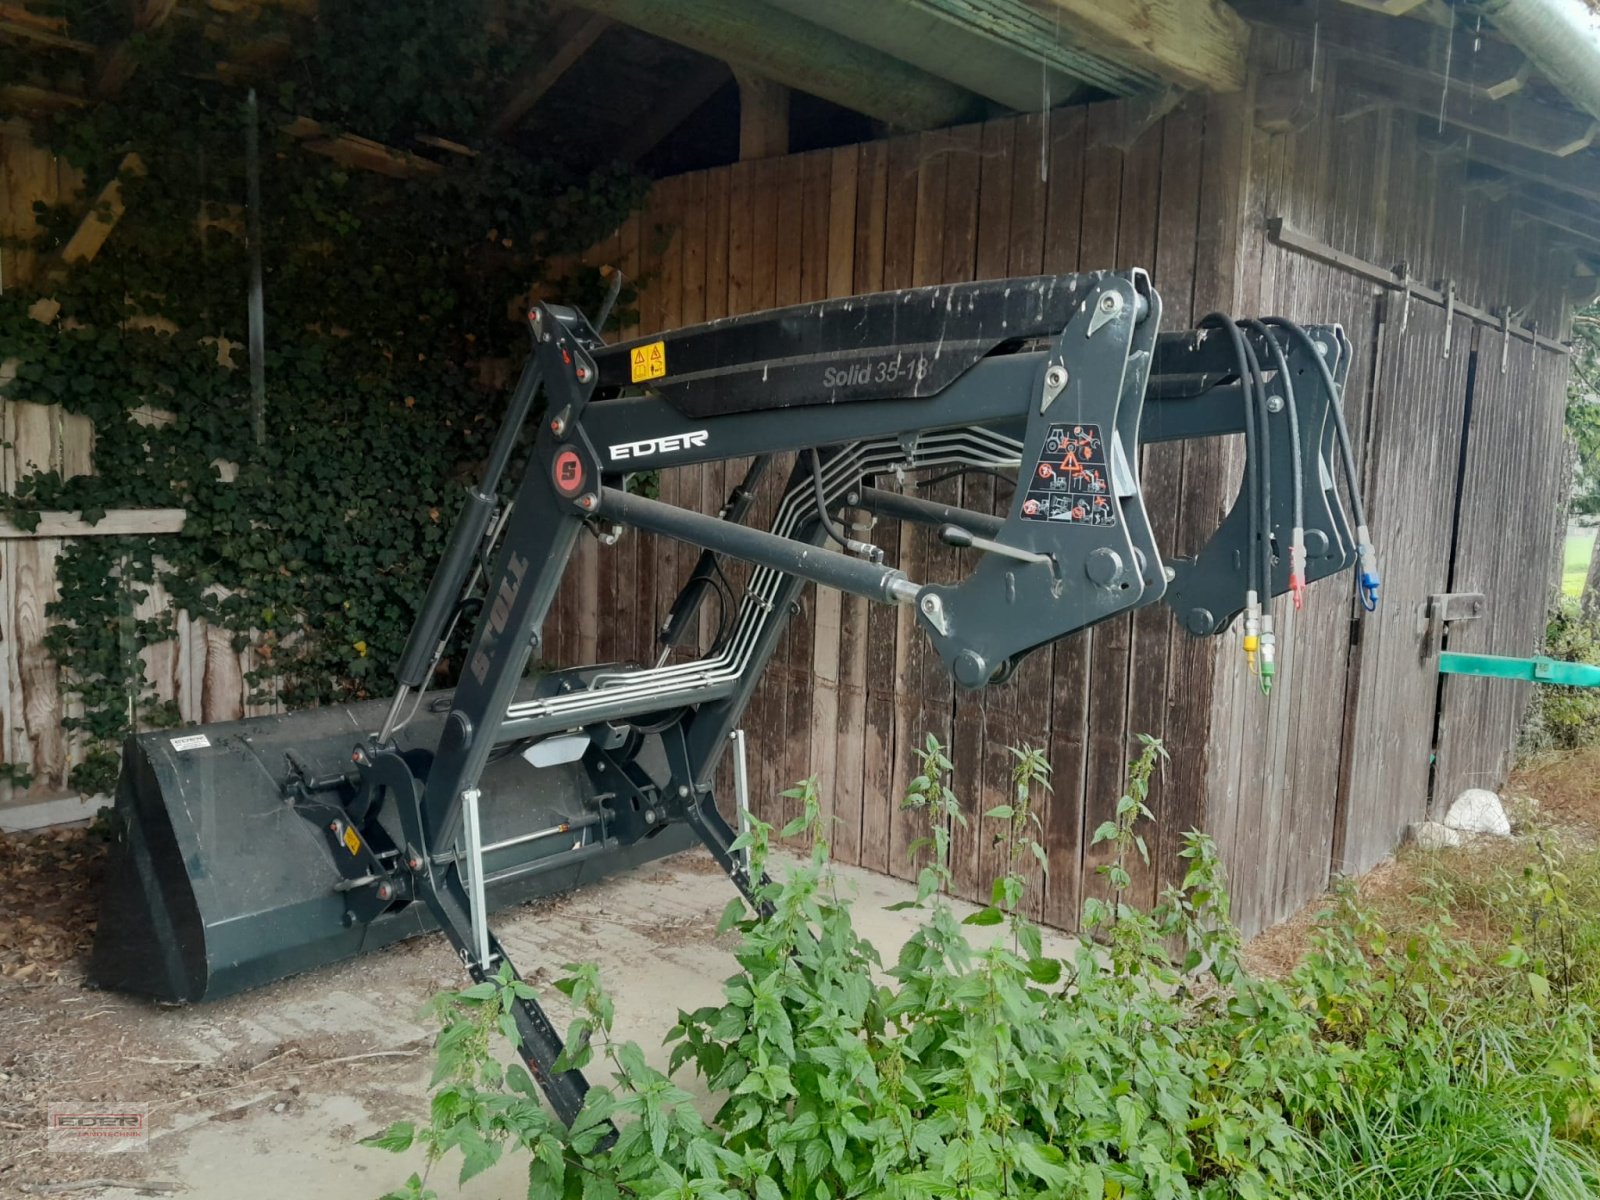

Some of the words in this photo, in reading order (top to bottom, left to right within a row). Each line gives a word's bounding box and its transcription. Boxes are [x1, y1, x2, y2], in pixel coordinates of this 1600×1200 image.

[823, 363, 872, 388] Solid
[875, 358, 929, 383] 35-18
[608, 429, 709, 461] EDER
